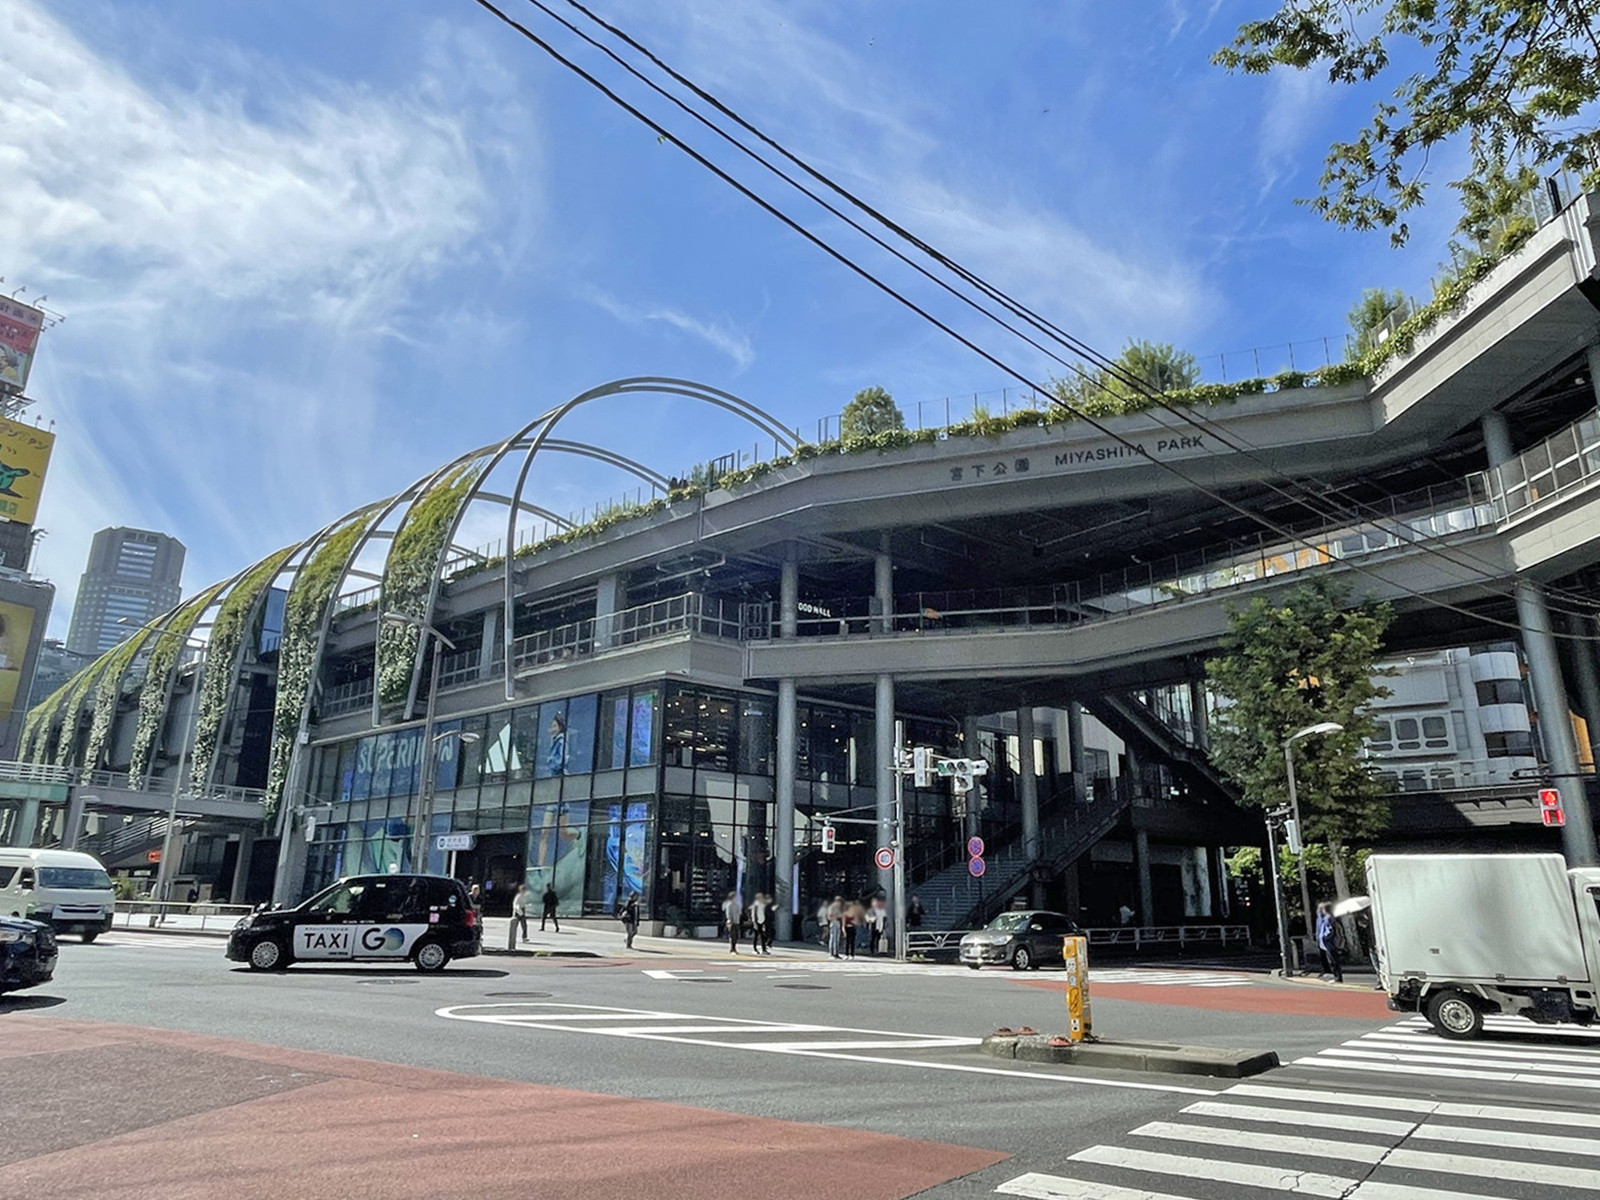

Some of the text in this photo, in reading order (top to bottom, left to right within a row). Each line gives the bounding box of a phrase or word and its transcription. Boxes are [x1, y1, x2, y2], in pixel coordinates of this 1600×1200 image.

[1055, 434, 1203, 466] MIYASHITA PARK
[950, 457, 1030, 482] 宮下公園
[304, 932, 349, 949] TAXI
